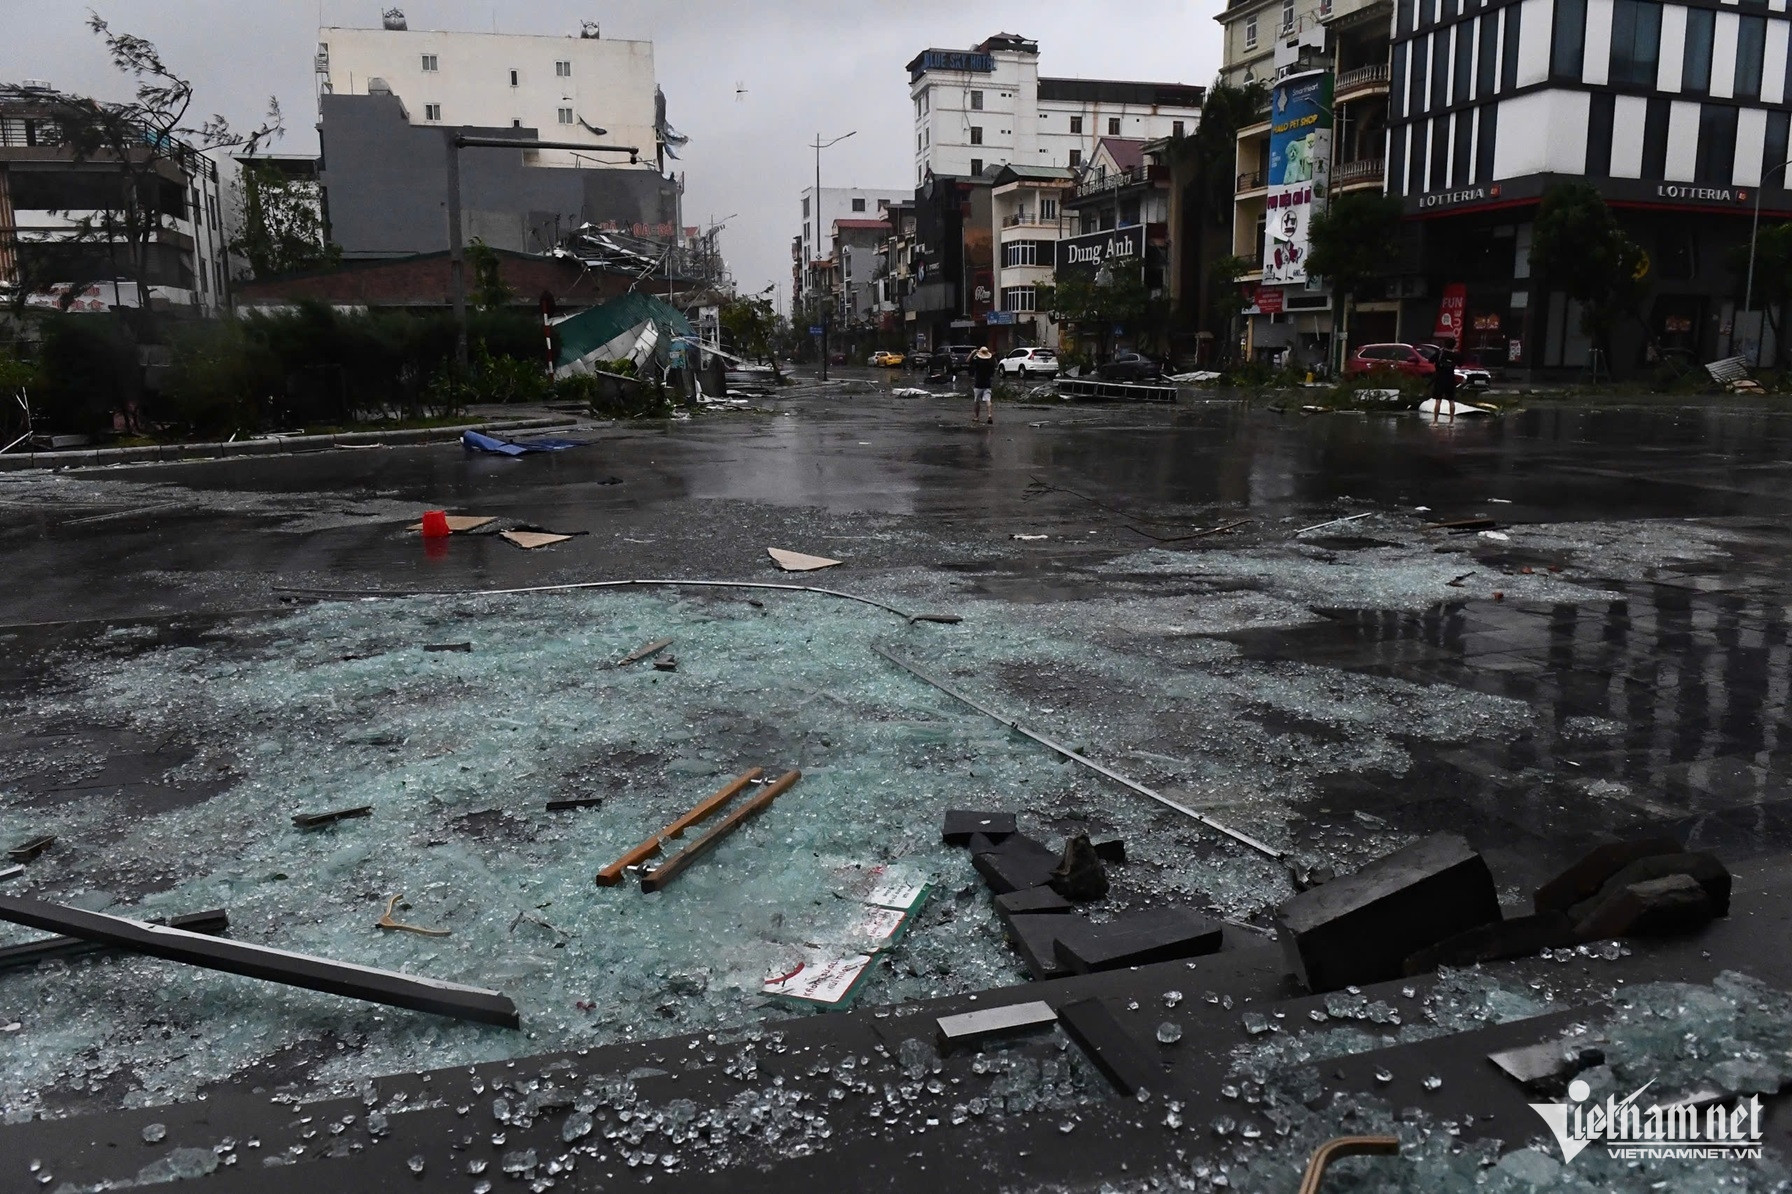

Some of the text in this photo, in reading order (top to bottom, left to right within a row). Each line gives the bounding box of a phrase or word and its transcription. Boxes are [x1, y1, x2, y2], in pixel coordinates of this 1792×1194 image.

[924, 52, 946, 68] BLUE
[950, 53, 967, 69] SKY
[970, 54, 997, 71] HOTEL
[1290, 119, 1299, 129] PET
[1300, 114, 1319, 127] SHOP
[1419, 188, 1485, 208] LOTTERIA
[1658, 185, 1730, 201] LOTTERIA
[1068, 245, 1102, 265] Dung
[1105, 235, 1133, 258] Anh
[1442, 297, 1463, 308] FUN
